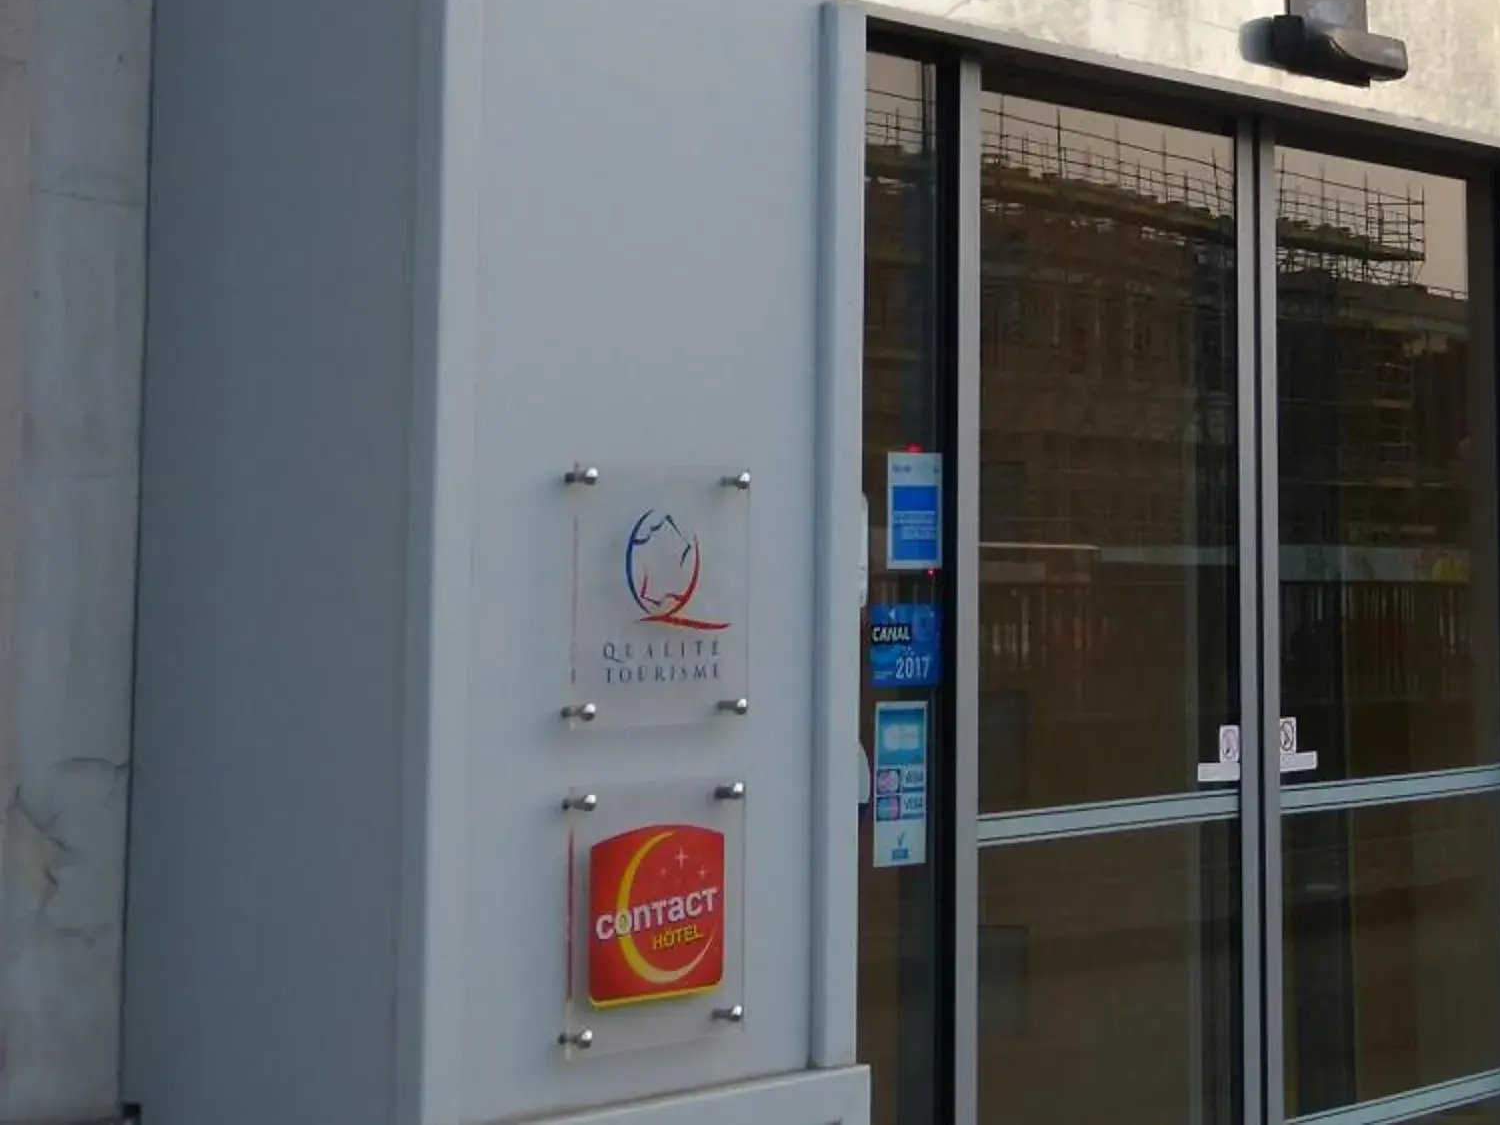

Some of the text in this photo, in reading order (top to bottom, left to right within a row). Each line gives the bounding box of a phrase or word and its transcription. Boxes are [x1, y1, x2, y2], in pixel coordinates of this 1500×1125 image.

[872, 625, 911, 642] CANAL
[604, 662, 721, 684] TOURISME
[895, 656, 931, 679] 2017
